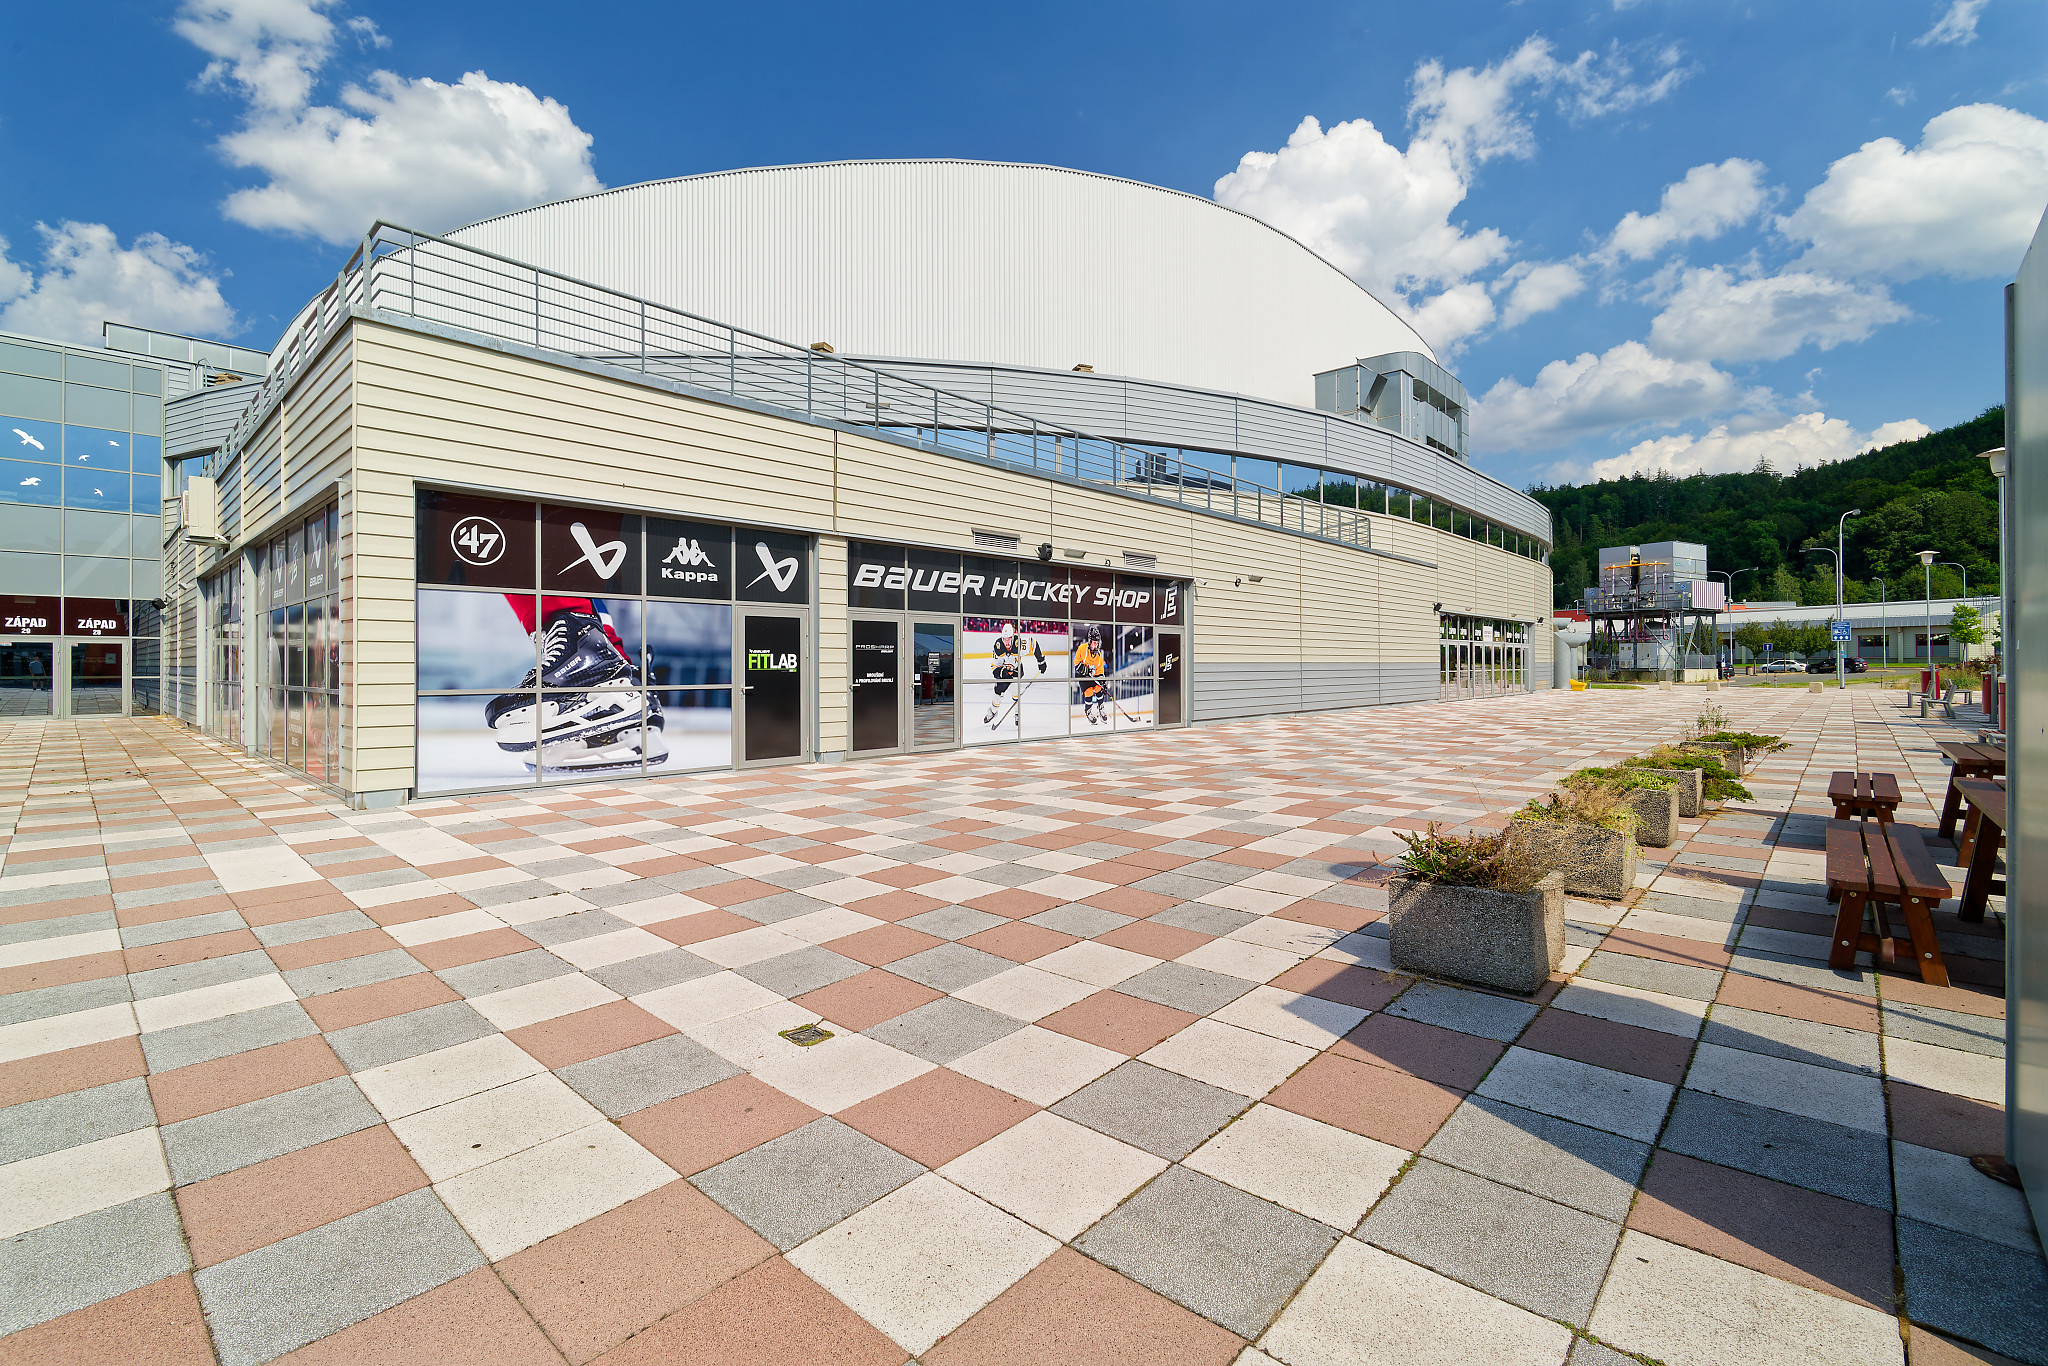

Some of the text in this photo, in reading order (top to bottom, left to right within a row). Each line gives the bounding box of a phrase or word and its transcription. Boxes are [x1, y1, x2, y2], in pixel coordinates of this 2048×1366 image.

[661, 567, 719, 583] Kappa
[989, 576, 1092, 604] HOCKEY
[1093, 587, 1151, 609] SHOP
[4, 615, 47, 628] ZÁPAD
[77, 617, 117, 630] ZÁPAD
[554, 656, 582, 679] BAUER
[748, 653, 798, 669] FITLAB
